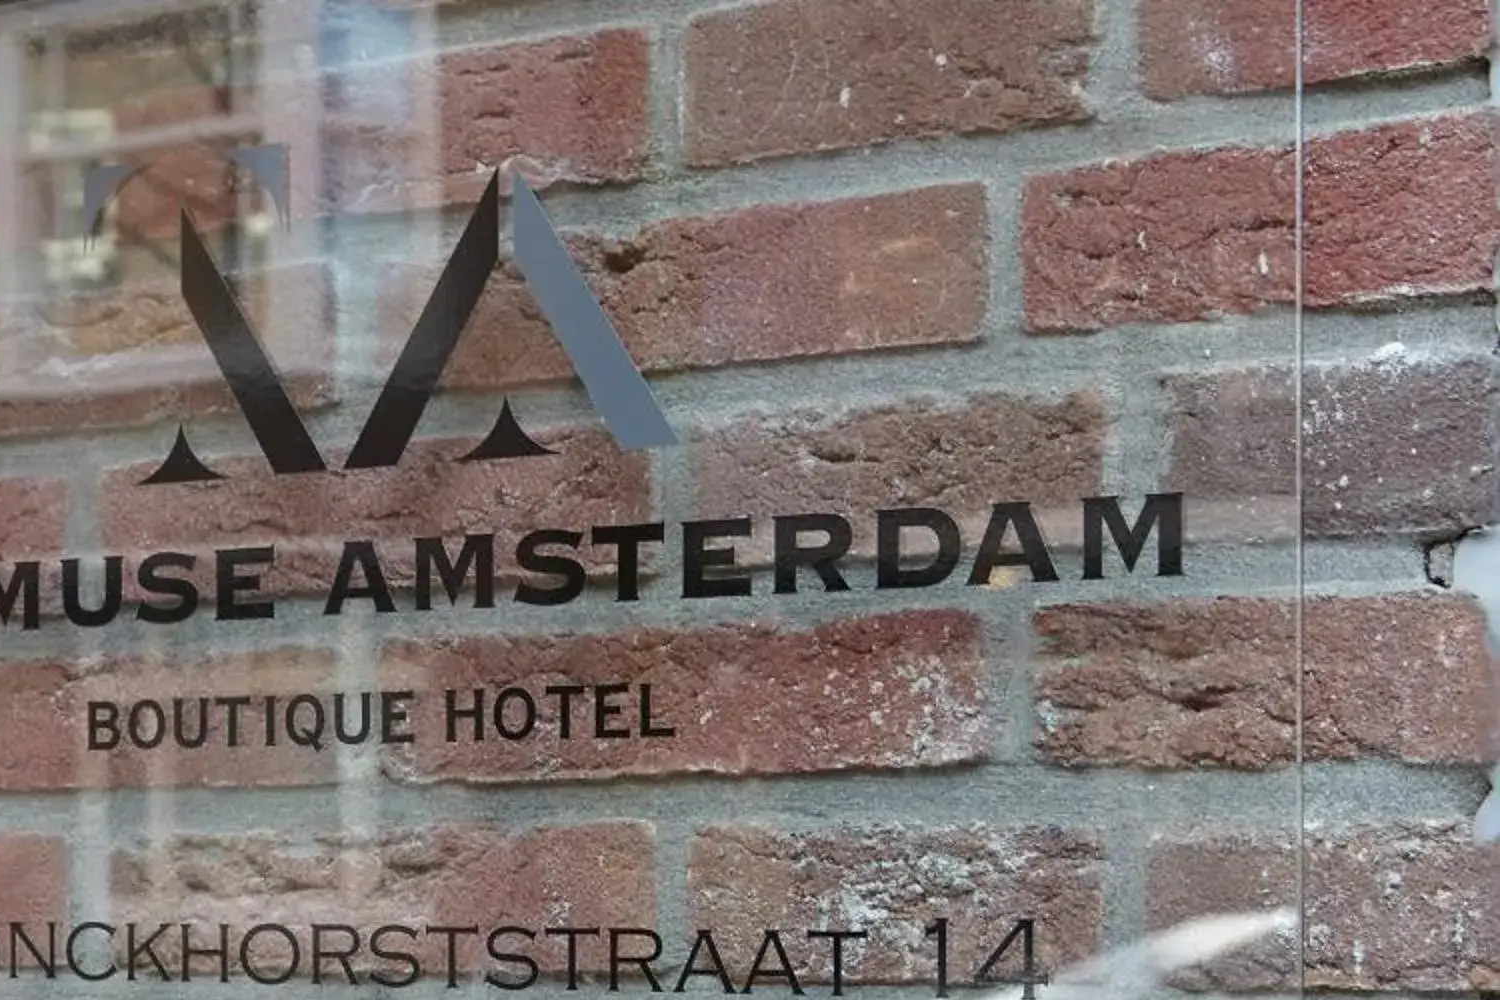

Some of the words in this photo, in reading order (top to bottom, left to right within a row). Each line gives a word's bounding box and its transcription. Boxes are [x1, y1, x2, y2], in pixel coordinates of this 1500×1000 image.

[323, 492, 1184, 616] AMSTERDAM
[86, 690, 415, 752] BOUTIQUE
[445, 683, 676, 743] HOTEL
[924, 917, 1050, 1000] 14
